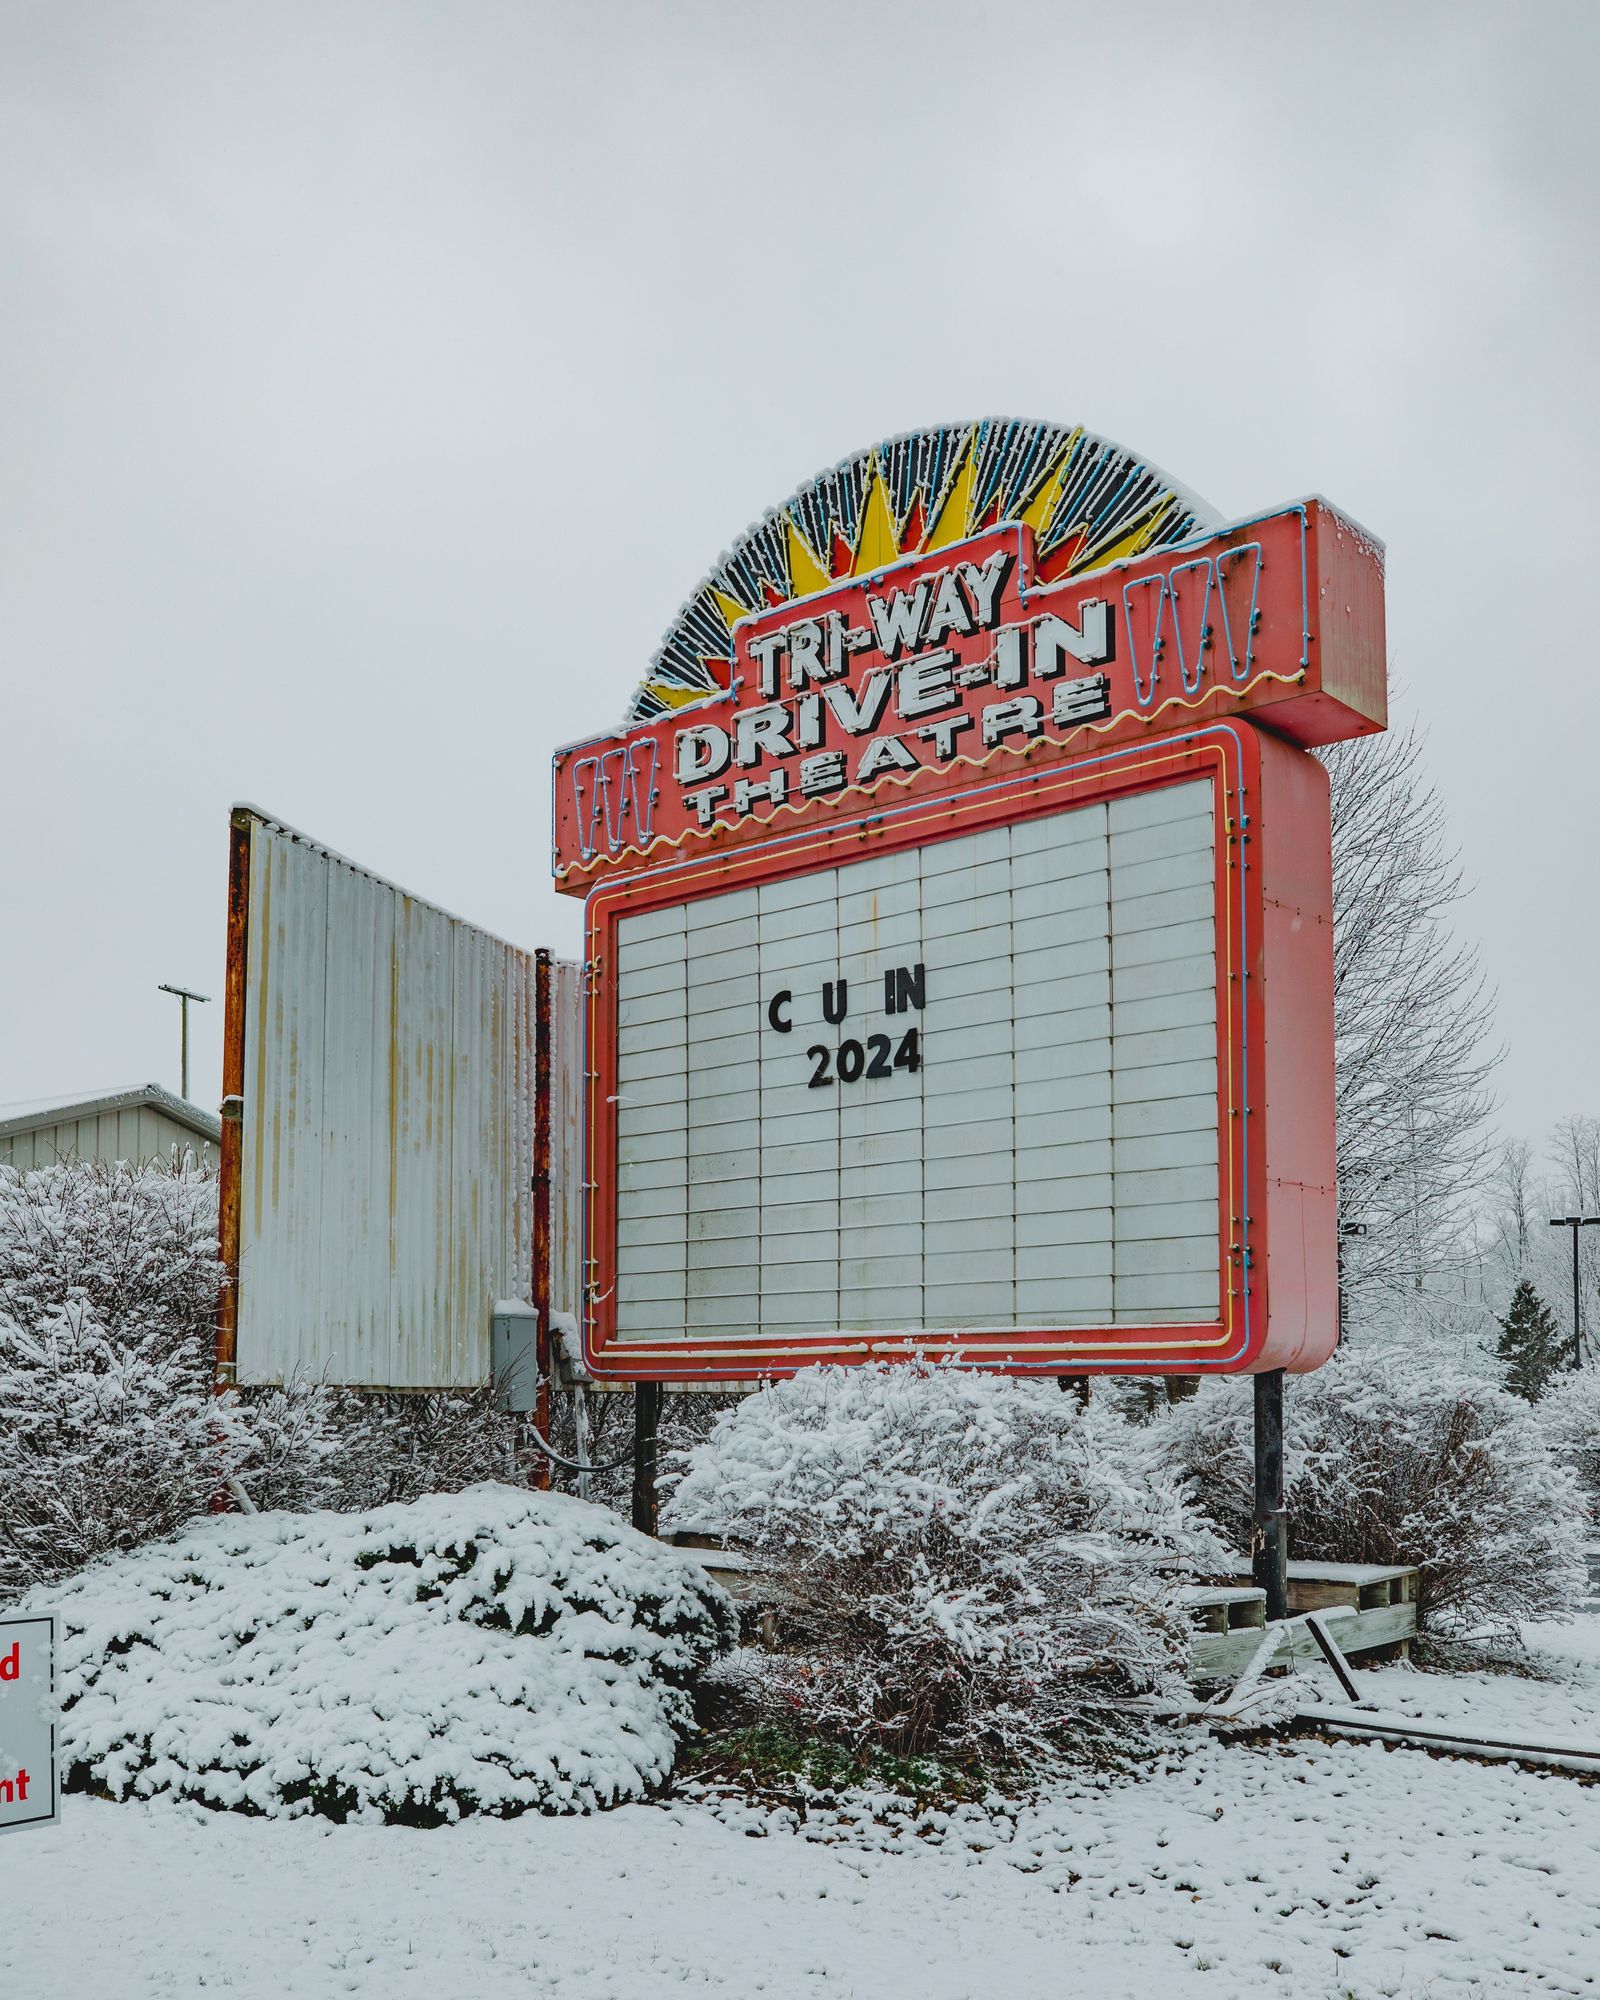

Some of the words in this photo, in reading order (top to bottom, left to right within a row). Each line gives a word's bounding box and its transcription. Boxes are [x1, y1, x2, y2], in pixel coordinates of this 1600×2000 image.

[673, 597, 1115, 785] DRIVE-IN
[745, 549, 1016, 697] TRI-WAY
[682, 673, 1111, 825] THEATRE
[768, 990, 792, 1033] C
[822, 979, 847, 1025] U
[884, 963, 926, 1015] IN
[806, 1027, 921, 1088] 2024
